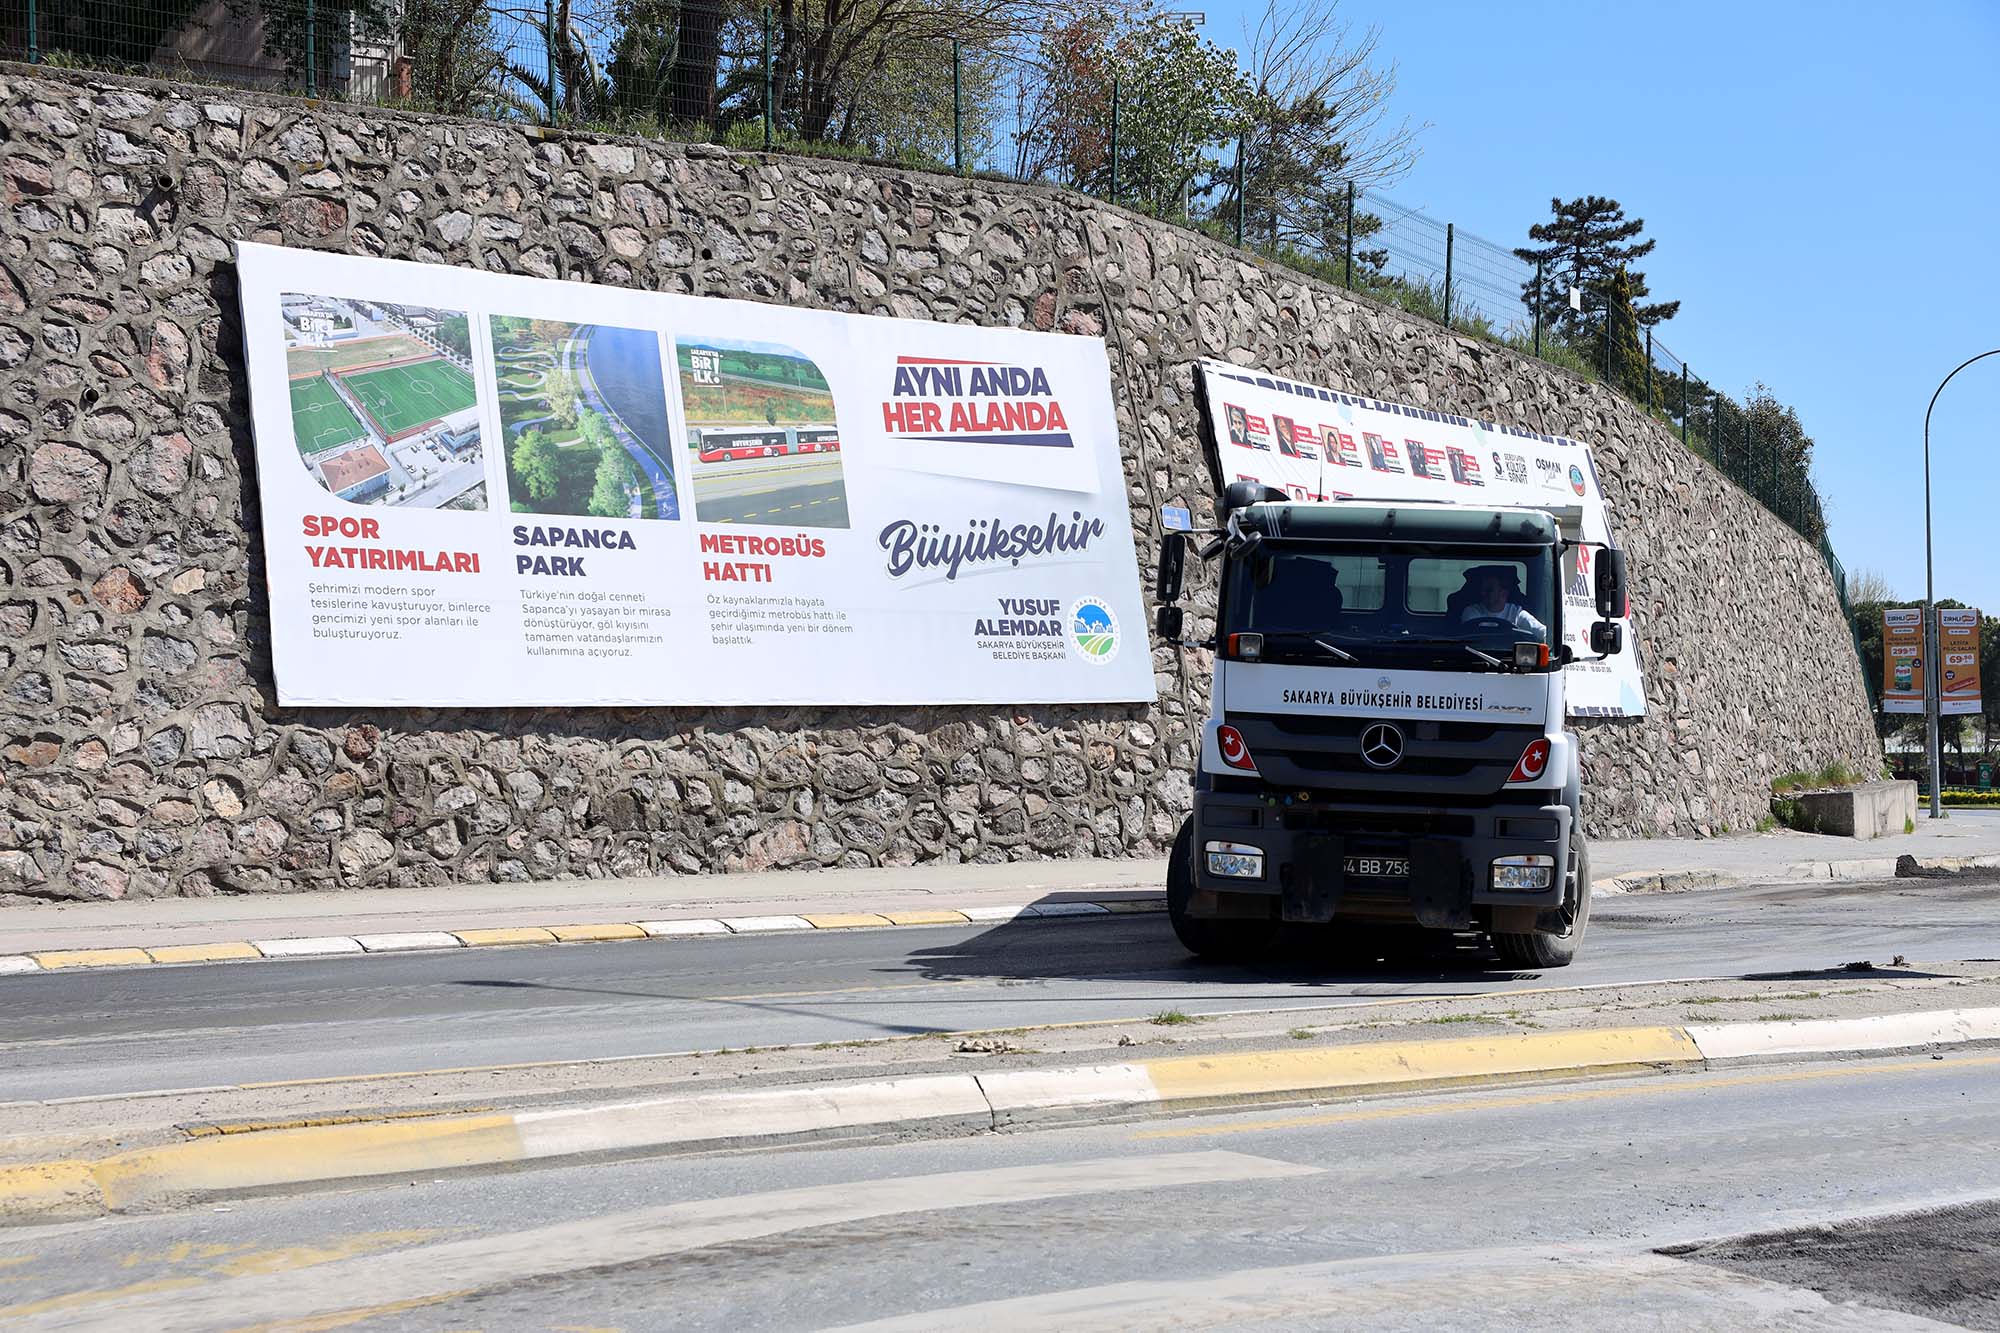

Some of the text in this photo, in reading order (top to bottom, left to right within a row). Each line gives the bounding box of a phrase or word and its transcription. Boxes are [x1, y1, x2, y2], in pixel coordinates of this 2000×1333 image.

[893, 366, 1053, 396] AYNI ANDA
[882, 401, 1068, 433] HER ALANDA
[1536, 458, 1561, 473] OSMAN
[302, 514, 380, 540] SPOR
[513, 525, 637, 551] SAPANCA
[700, 533, 826, 559] METROBÜS
[879, 511, 1105, 581] Büyükşehir
[305, 545, 481, 574] YATIRIMLARI
[516, 554, 587, 577] PARK
[703, 561, 772, 583] HATTI
[308, 582, 436, 597] Şehrimizi modern spor
[520, 589, 646, 603] Türkiye'nin doğal cenneti
[311, 599, 491, 613] tesislerine kavuşturuyor, binlerce
[706, 592, 825, 608] Öz kaynaklarımızla hayata
[998, 598, 1061, 616] YUSUF
[522, 603, 671, 617] Sapanca'yı yaşayan bir mirasa
[709, 608, 766, 620] geçirdiğimiz
[768, 609, 812, 620] metrobüs
[813, 610, 834, 621] hattı
[312, 613, 367, 626] gencimizi
[370, 614, 393, 626] yeni
[396, 616, 421, 627] spor
[424, 615, 464, 627] alanları
[523, 618, 649, 631] dönüştürüyor, göl kıyısını
[710, 621, 854, 634] şehir ulaşımında yeni bir dönem
[313, 627, 402, 641] buluşturuyoruz.
[974, 619, 1063, 637] ALEMDAR
[525, 632, 664, 644] tamamen vatandaşlarımızın
[976, 639, 1065, 650] SAKARYA BÜYÜKŞEHİR
[527, 646, 633, 658] kullanımına açıyoruz.
[992, 651, 1066, 661] BELEDİYE BAŞKANI
[1283, 689, 1483, 711] SAKARYA BÜYÜKŞEHİR BELEDİYESİ
[1360, 860, 1380, 874] BB
